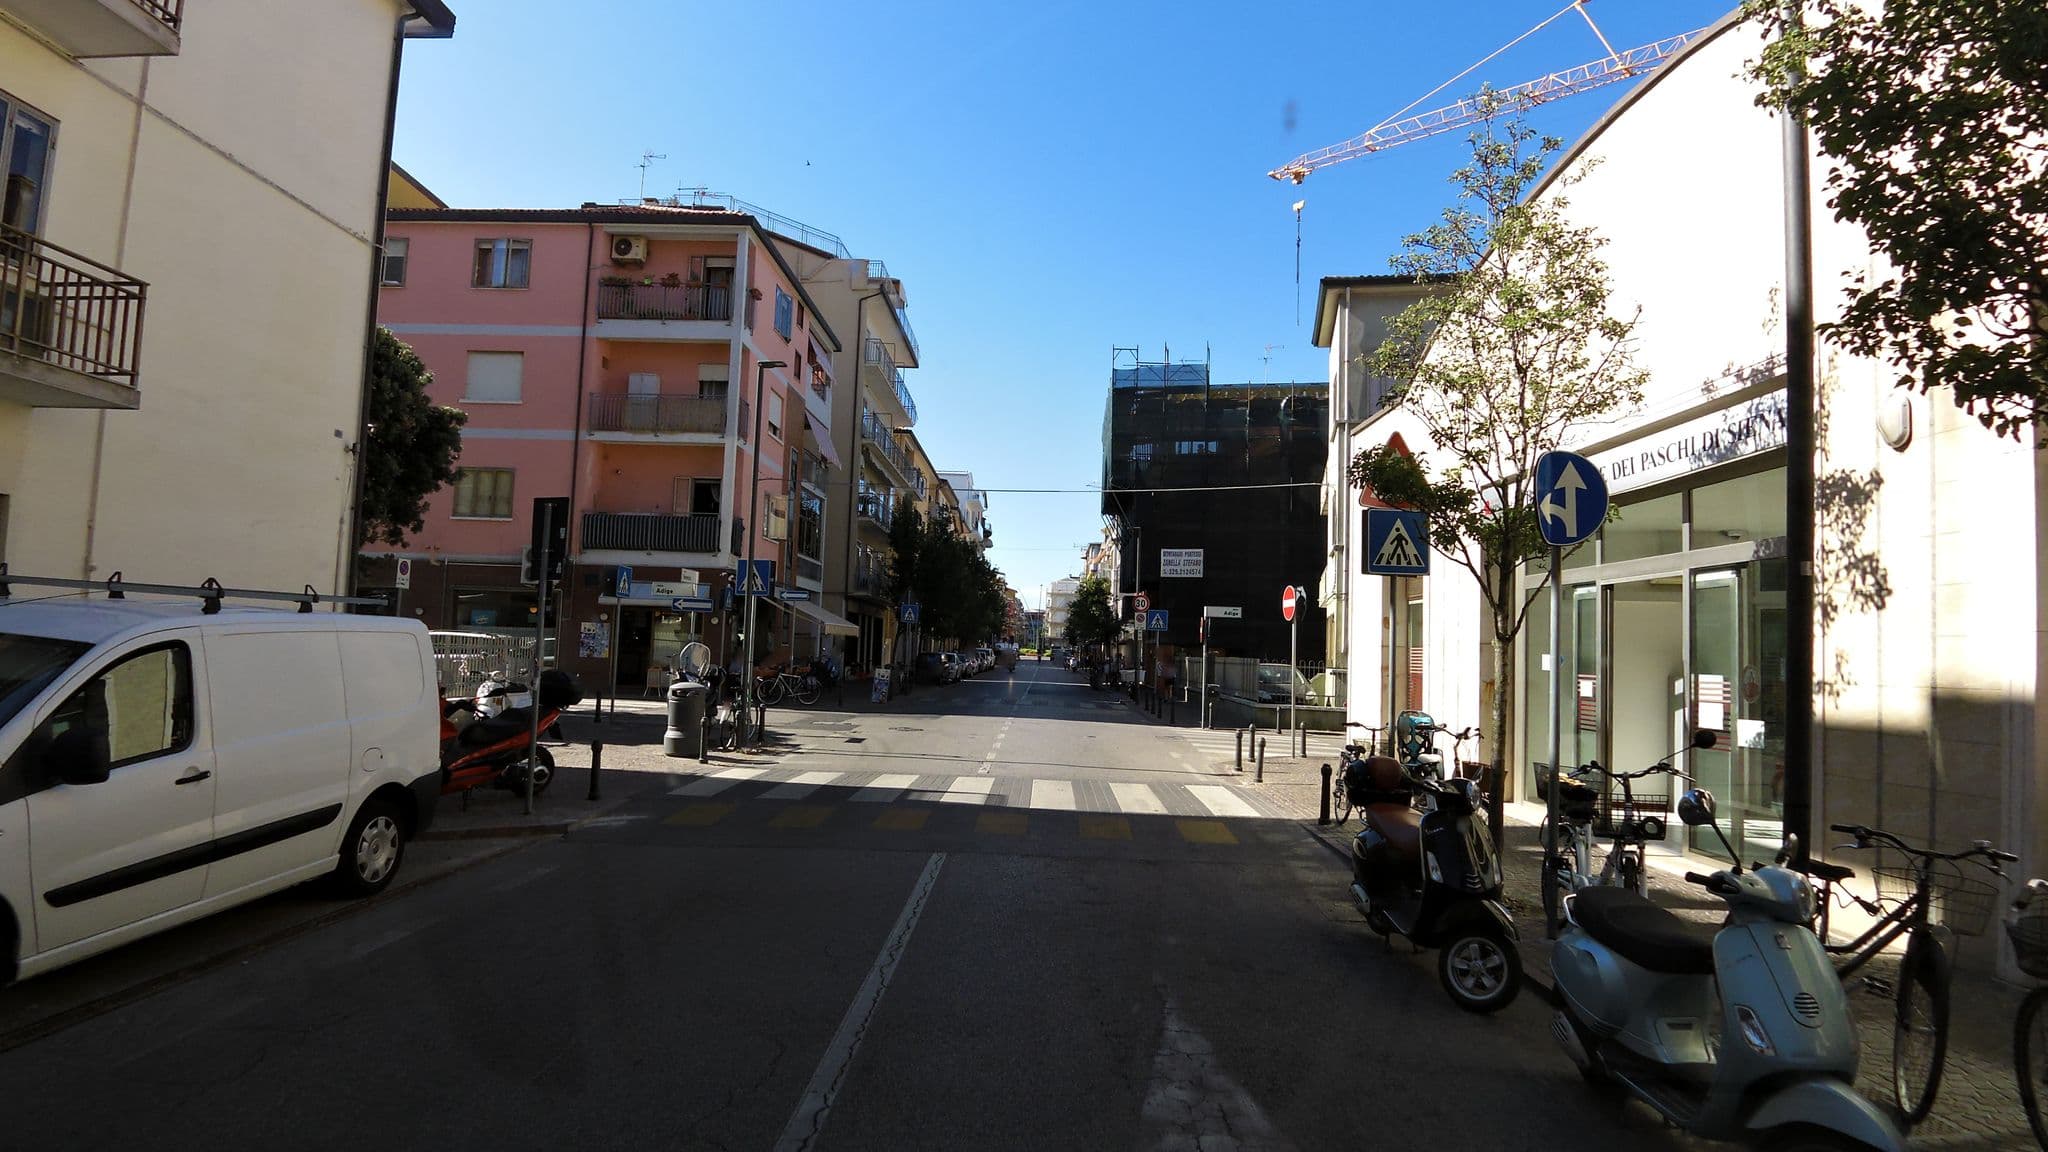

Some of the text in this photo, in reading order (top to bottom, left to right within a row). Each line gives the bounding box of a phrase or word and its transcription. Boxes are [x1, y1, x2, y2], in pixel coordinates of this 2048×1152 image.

[1611, 455, 1636, 481] DEI
[1641, 436, 1696, 471] PASCHI
[1702, 427, 1721, 452] DI
[1727, 407, 1787, 444] SIENA
[1135, 599, 1146, 608] 30
